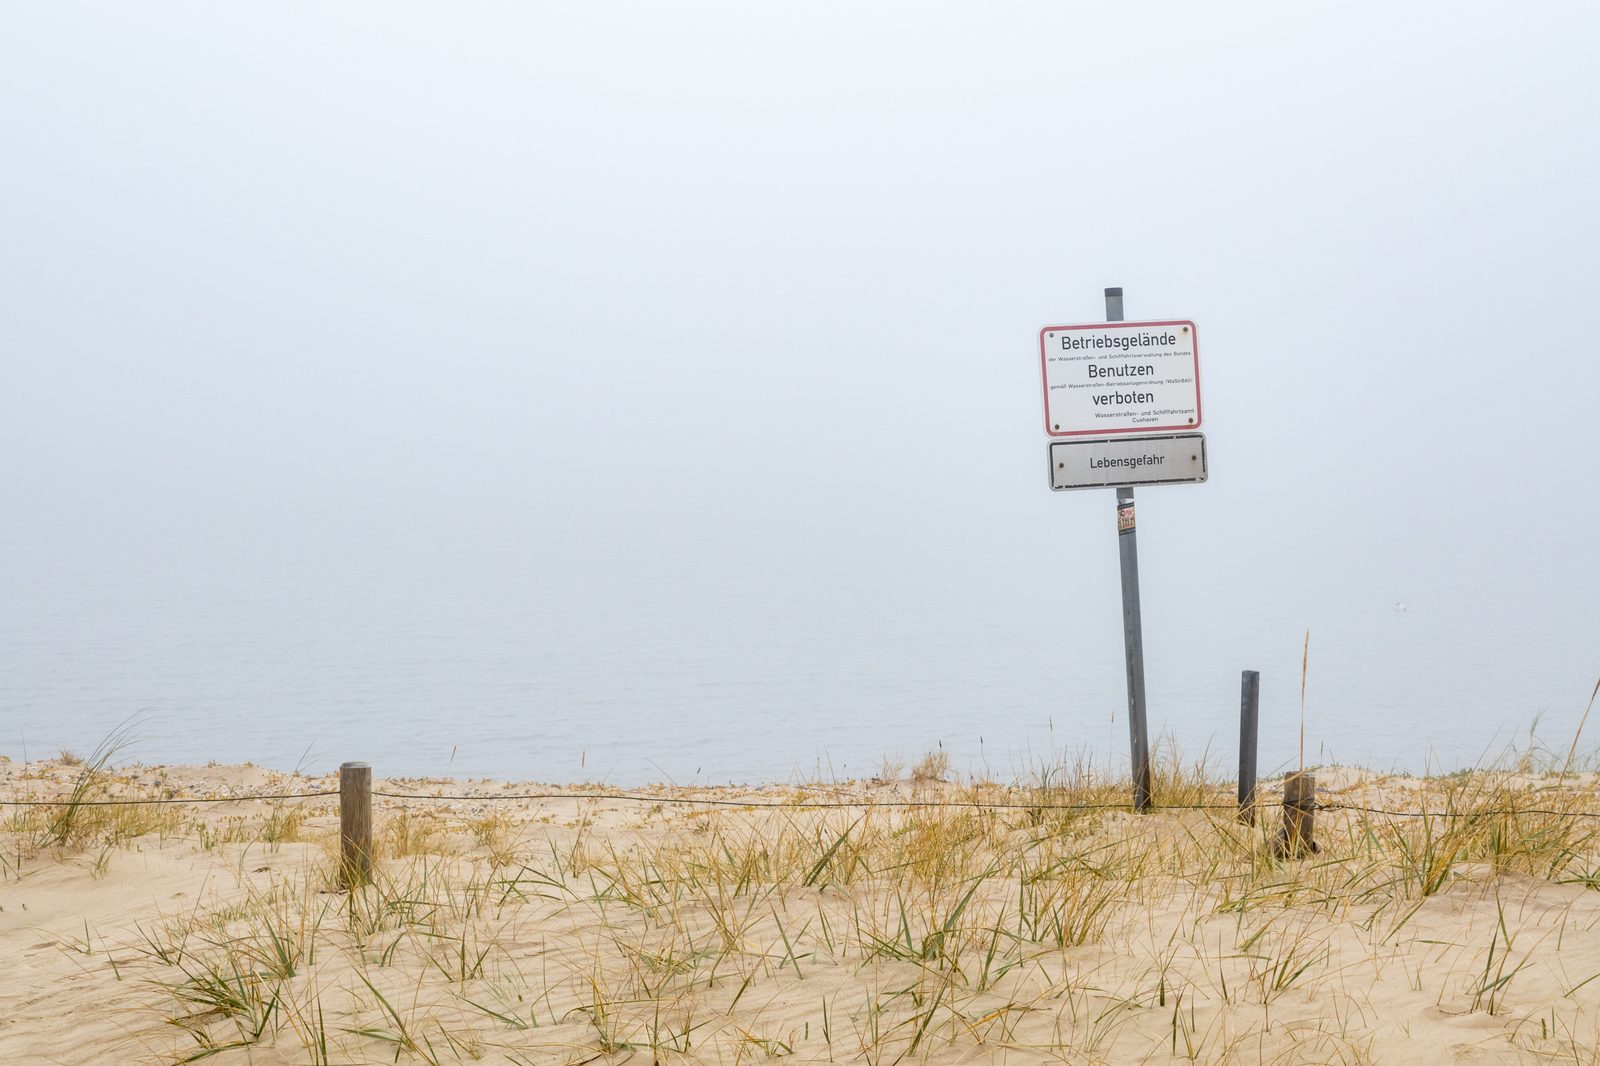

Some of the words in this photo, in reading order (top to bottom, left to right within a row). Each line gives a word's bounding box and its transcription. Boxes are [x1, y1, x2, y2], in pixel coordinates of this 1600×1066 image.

[1061, 332, 1176, 350] Betriebsgelände
[1088, 364, 1154, 378] Benutzen
[1092, 391, 1154, 405] verboten
[1090, 454, 1165, 469] Lebensgefahr
